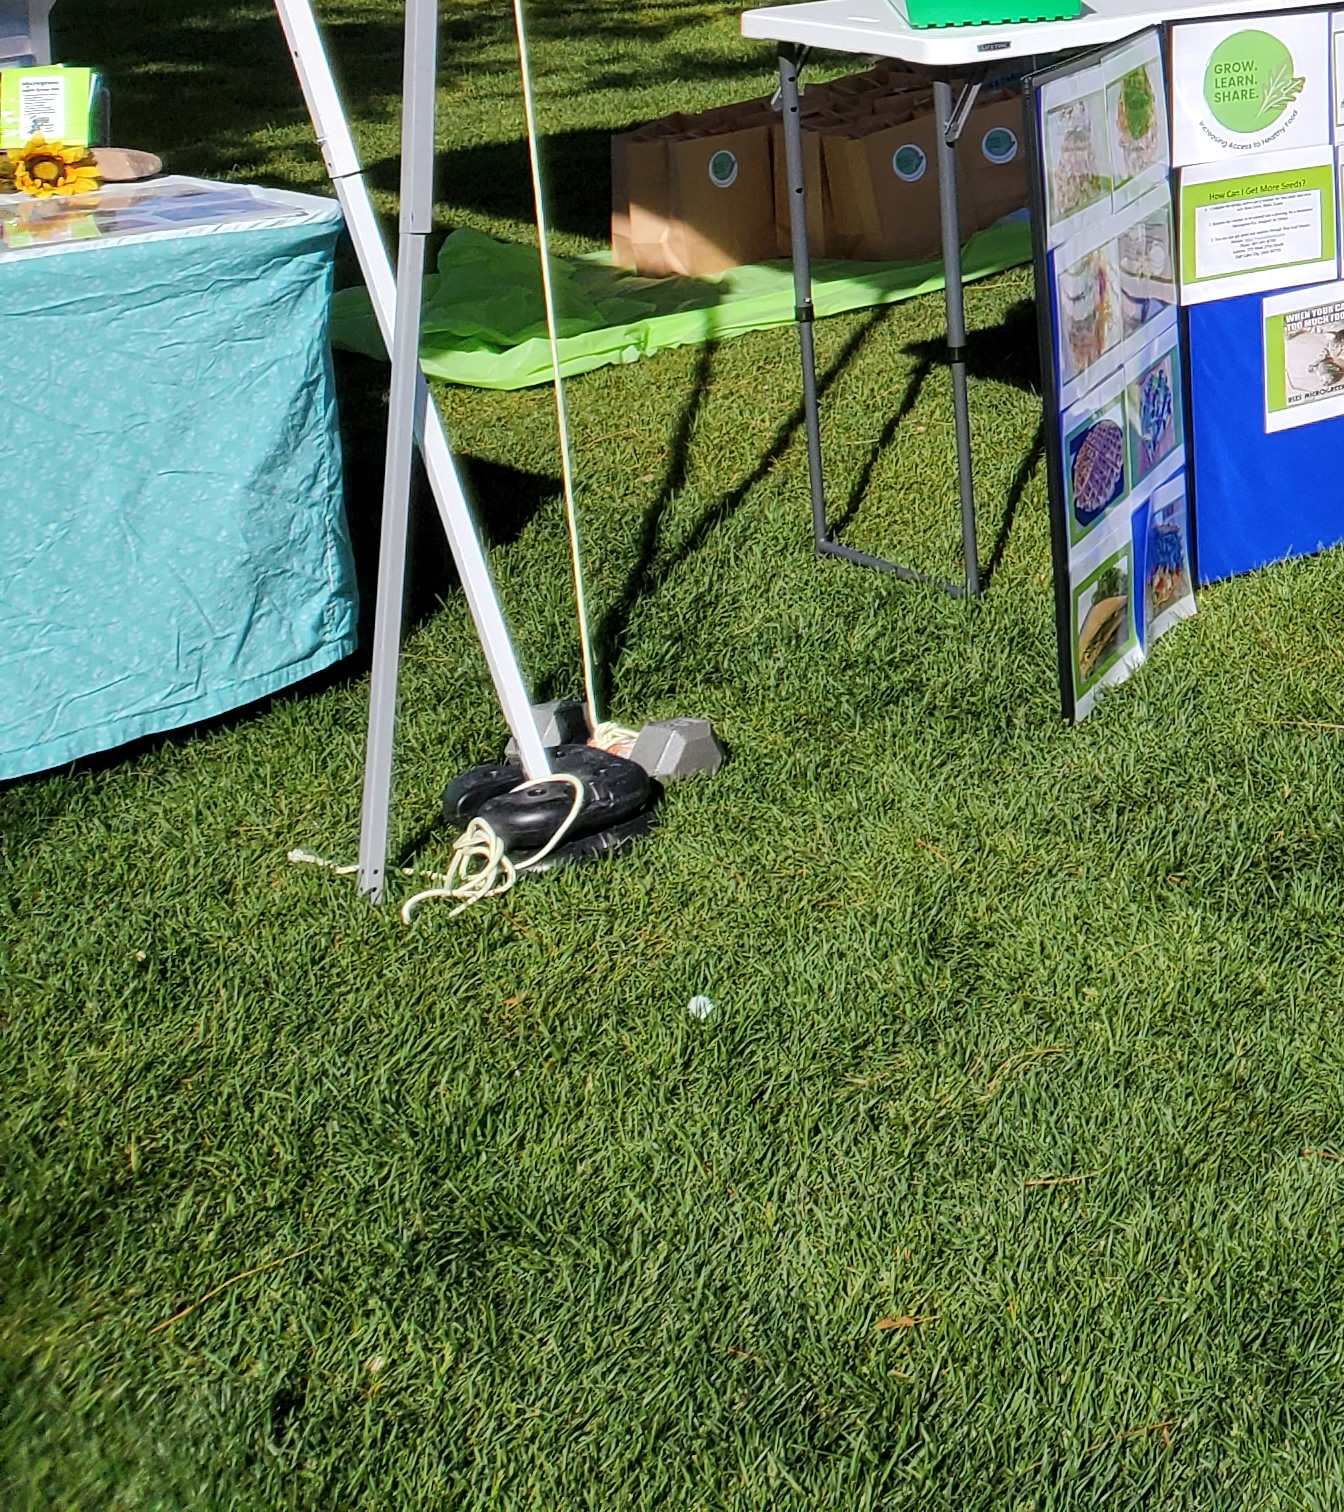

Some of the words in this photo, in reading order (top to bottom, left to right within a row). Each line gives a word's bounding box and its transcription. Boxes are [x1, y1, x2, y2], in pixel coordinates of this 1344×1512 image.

[1214, 60, 1258, 75] GROW.
[1214, 74, 1258, 89] LEARN.
[1214, 88, 1259, 103] SHARE.
[1199, 121, 1228, 149] Increasing
[1228, 142, 1252, 150] Access
[1253, 140, 1261, 148] to
[1261, 126, 1286, 146] Healthy
[1285, 109, 1298, 128] Food
[1209, 192, 1226, 201] How
[1227, 190, 1240, 199] Can
[1246, 187, 1259, 195] Get
[1260, 183, 1280, 192] More
[1281, 179, 1306, 190] Seeds?
[1285, 310, 1311, 324] WHEN
[1311, 305, 1334, 318] YOUR
[1285, 322, 1303, 332] TOO
[1304, 316, 1329, 328] MUCH
